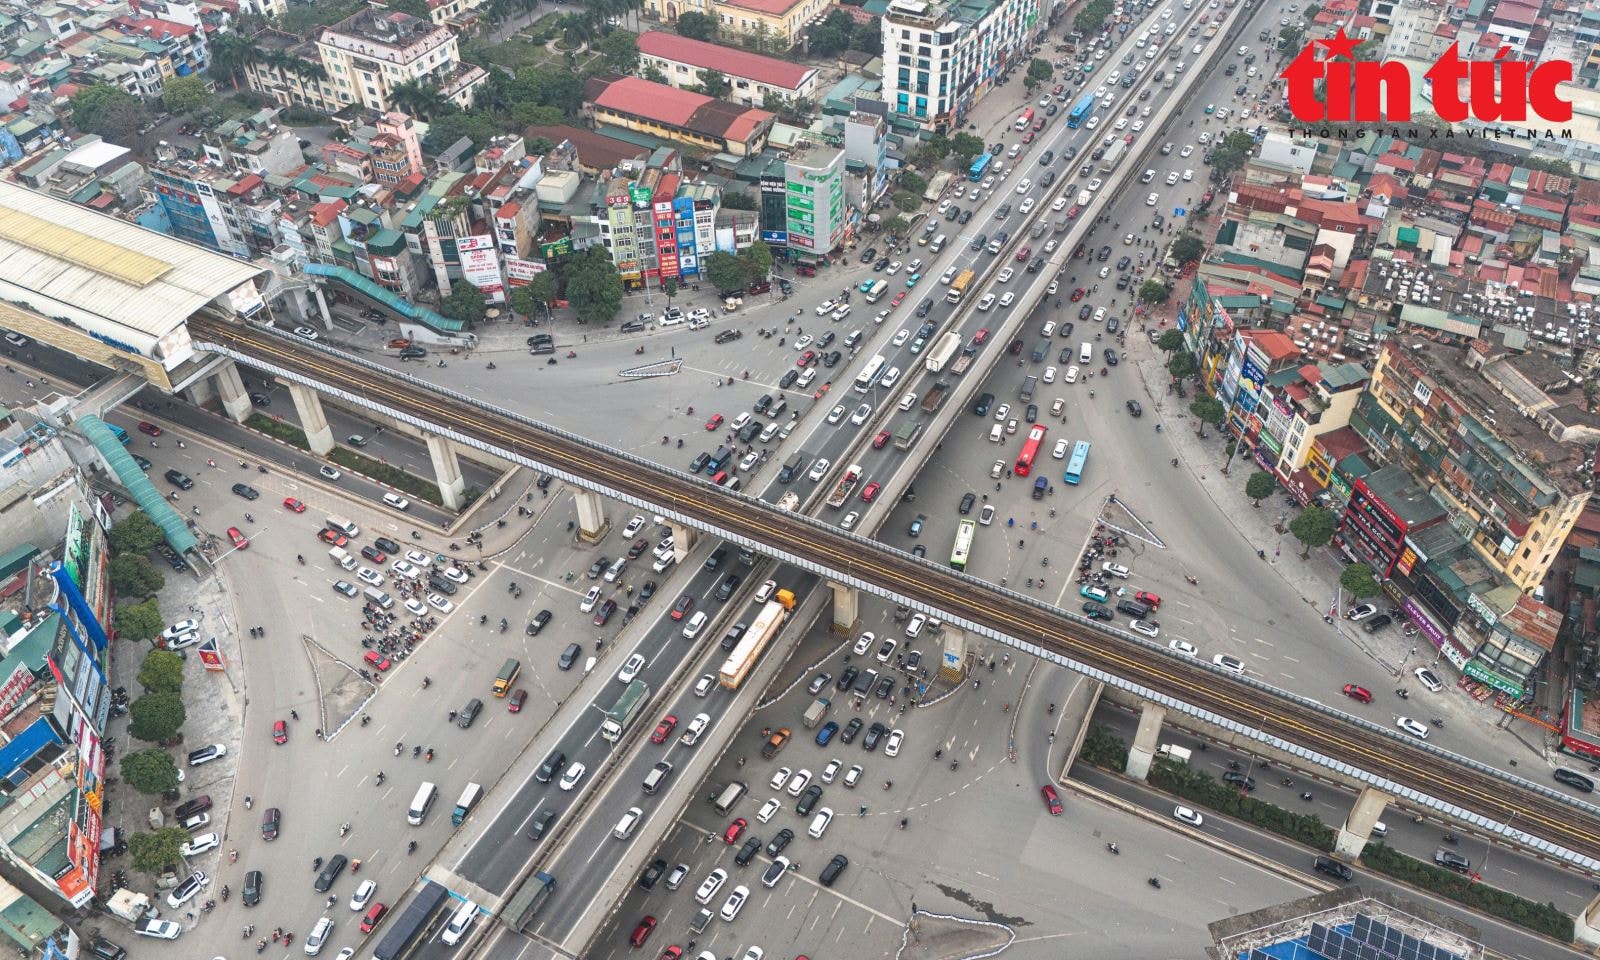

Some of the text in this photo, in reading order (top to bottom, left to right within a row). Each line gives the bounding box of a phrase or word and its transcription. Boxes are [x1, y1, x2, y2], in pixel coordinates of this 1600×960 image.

[1407, 603, 1442, 640] KLEVER FRUIT
[1467, 665, 1489, 680] FRESH
